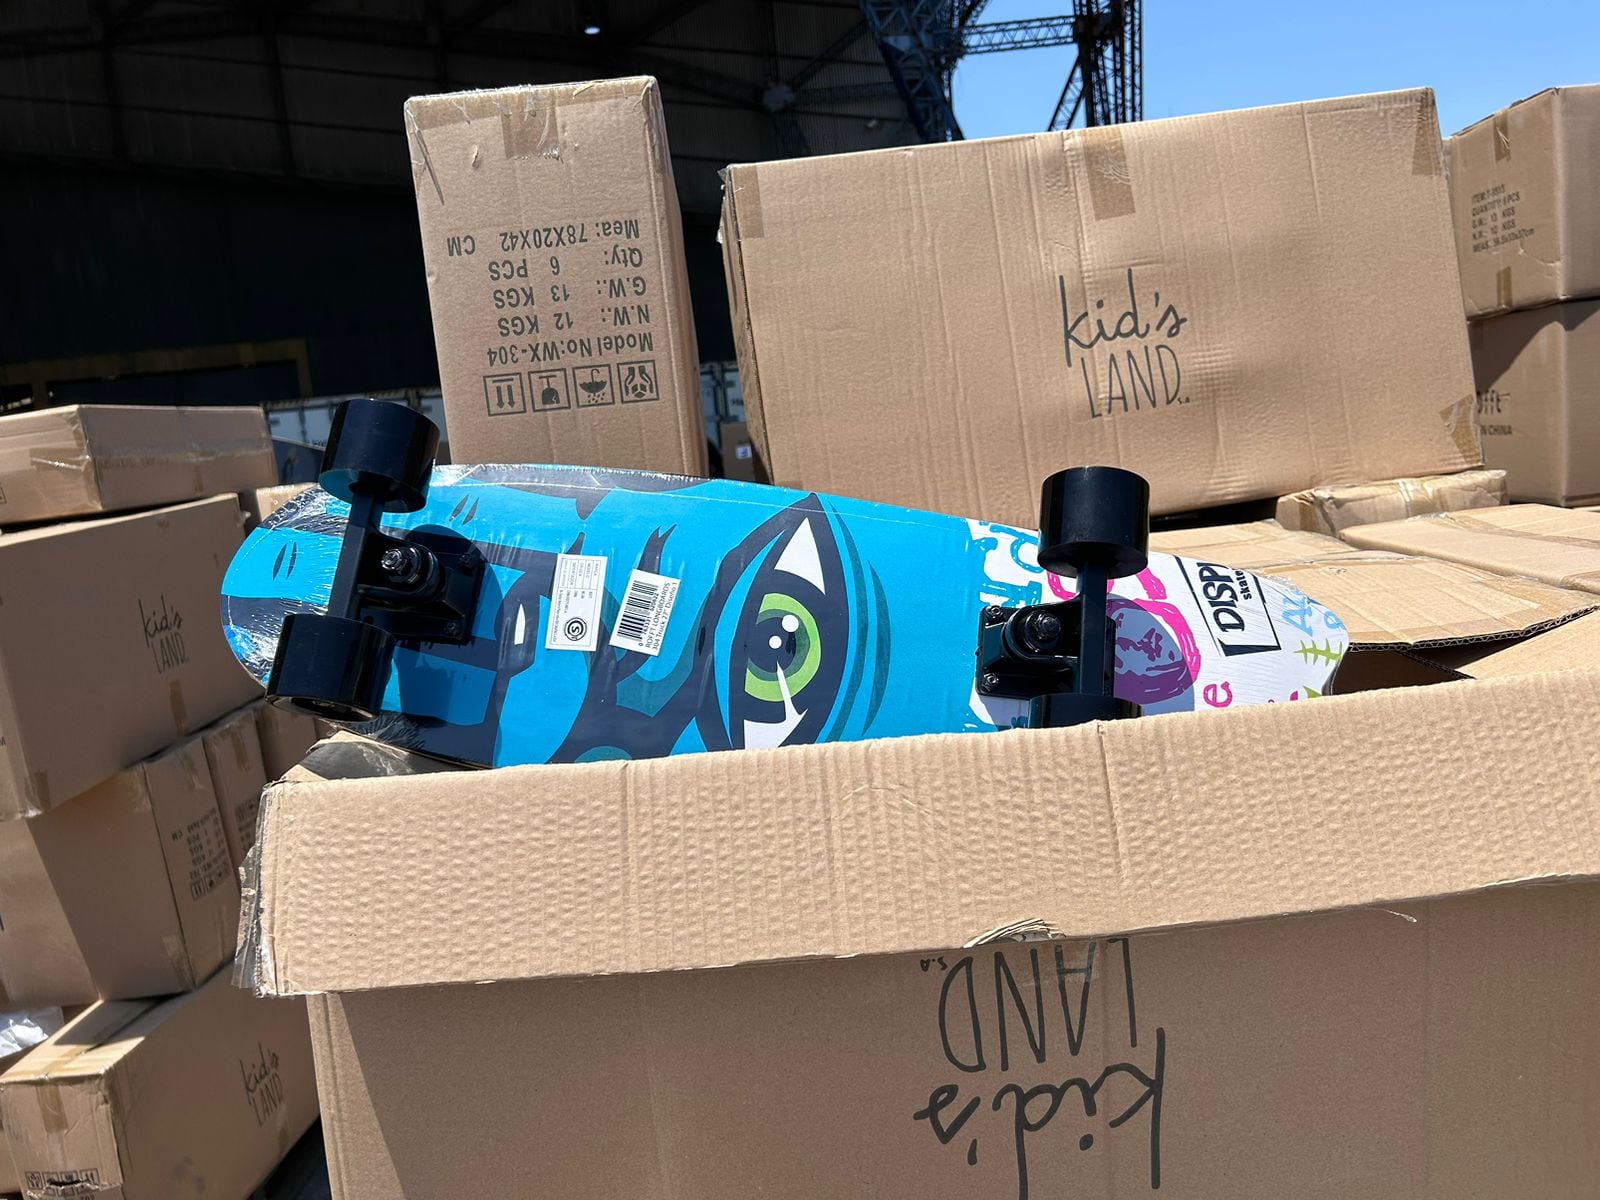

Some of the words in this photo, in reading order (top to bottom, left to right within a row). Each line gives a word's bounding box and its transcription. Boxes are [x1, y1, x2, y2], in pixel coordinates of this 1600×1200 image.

[499, 223, 588, 251] 78X20X42
[595, 219, 640, 240] Mea:
[446, 235, 476, 257] CM
[604, 244, 643, 268] Qty:
[488, 259, 529, 281] PCS
[549, 256, 560, 276] 6
[493, 286, 535, 309] KGS
[550, 284, 570, 302] 13
[596, 276, 647, 299] G.W.:
[497, 314, 540, 337] KGS
[553, 311, 574, 331] 12
[601, 304, 651, 326] N.W.:
[1059, 268, 1188, 368] kid's
[596, 332, 654, 356] Model
[138, 594, 183, 648] kid's
[656, 621, 667, 638] Truck
[239, 1041, 279, 1106] kid's
[913, 1028, 1166, 1200] kid's
